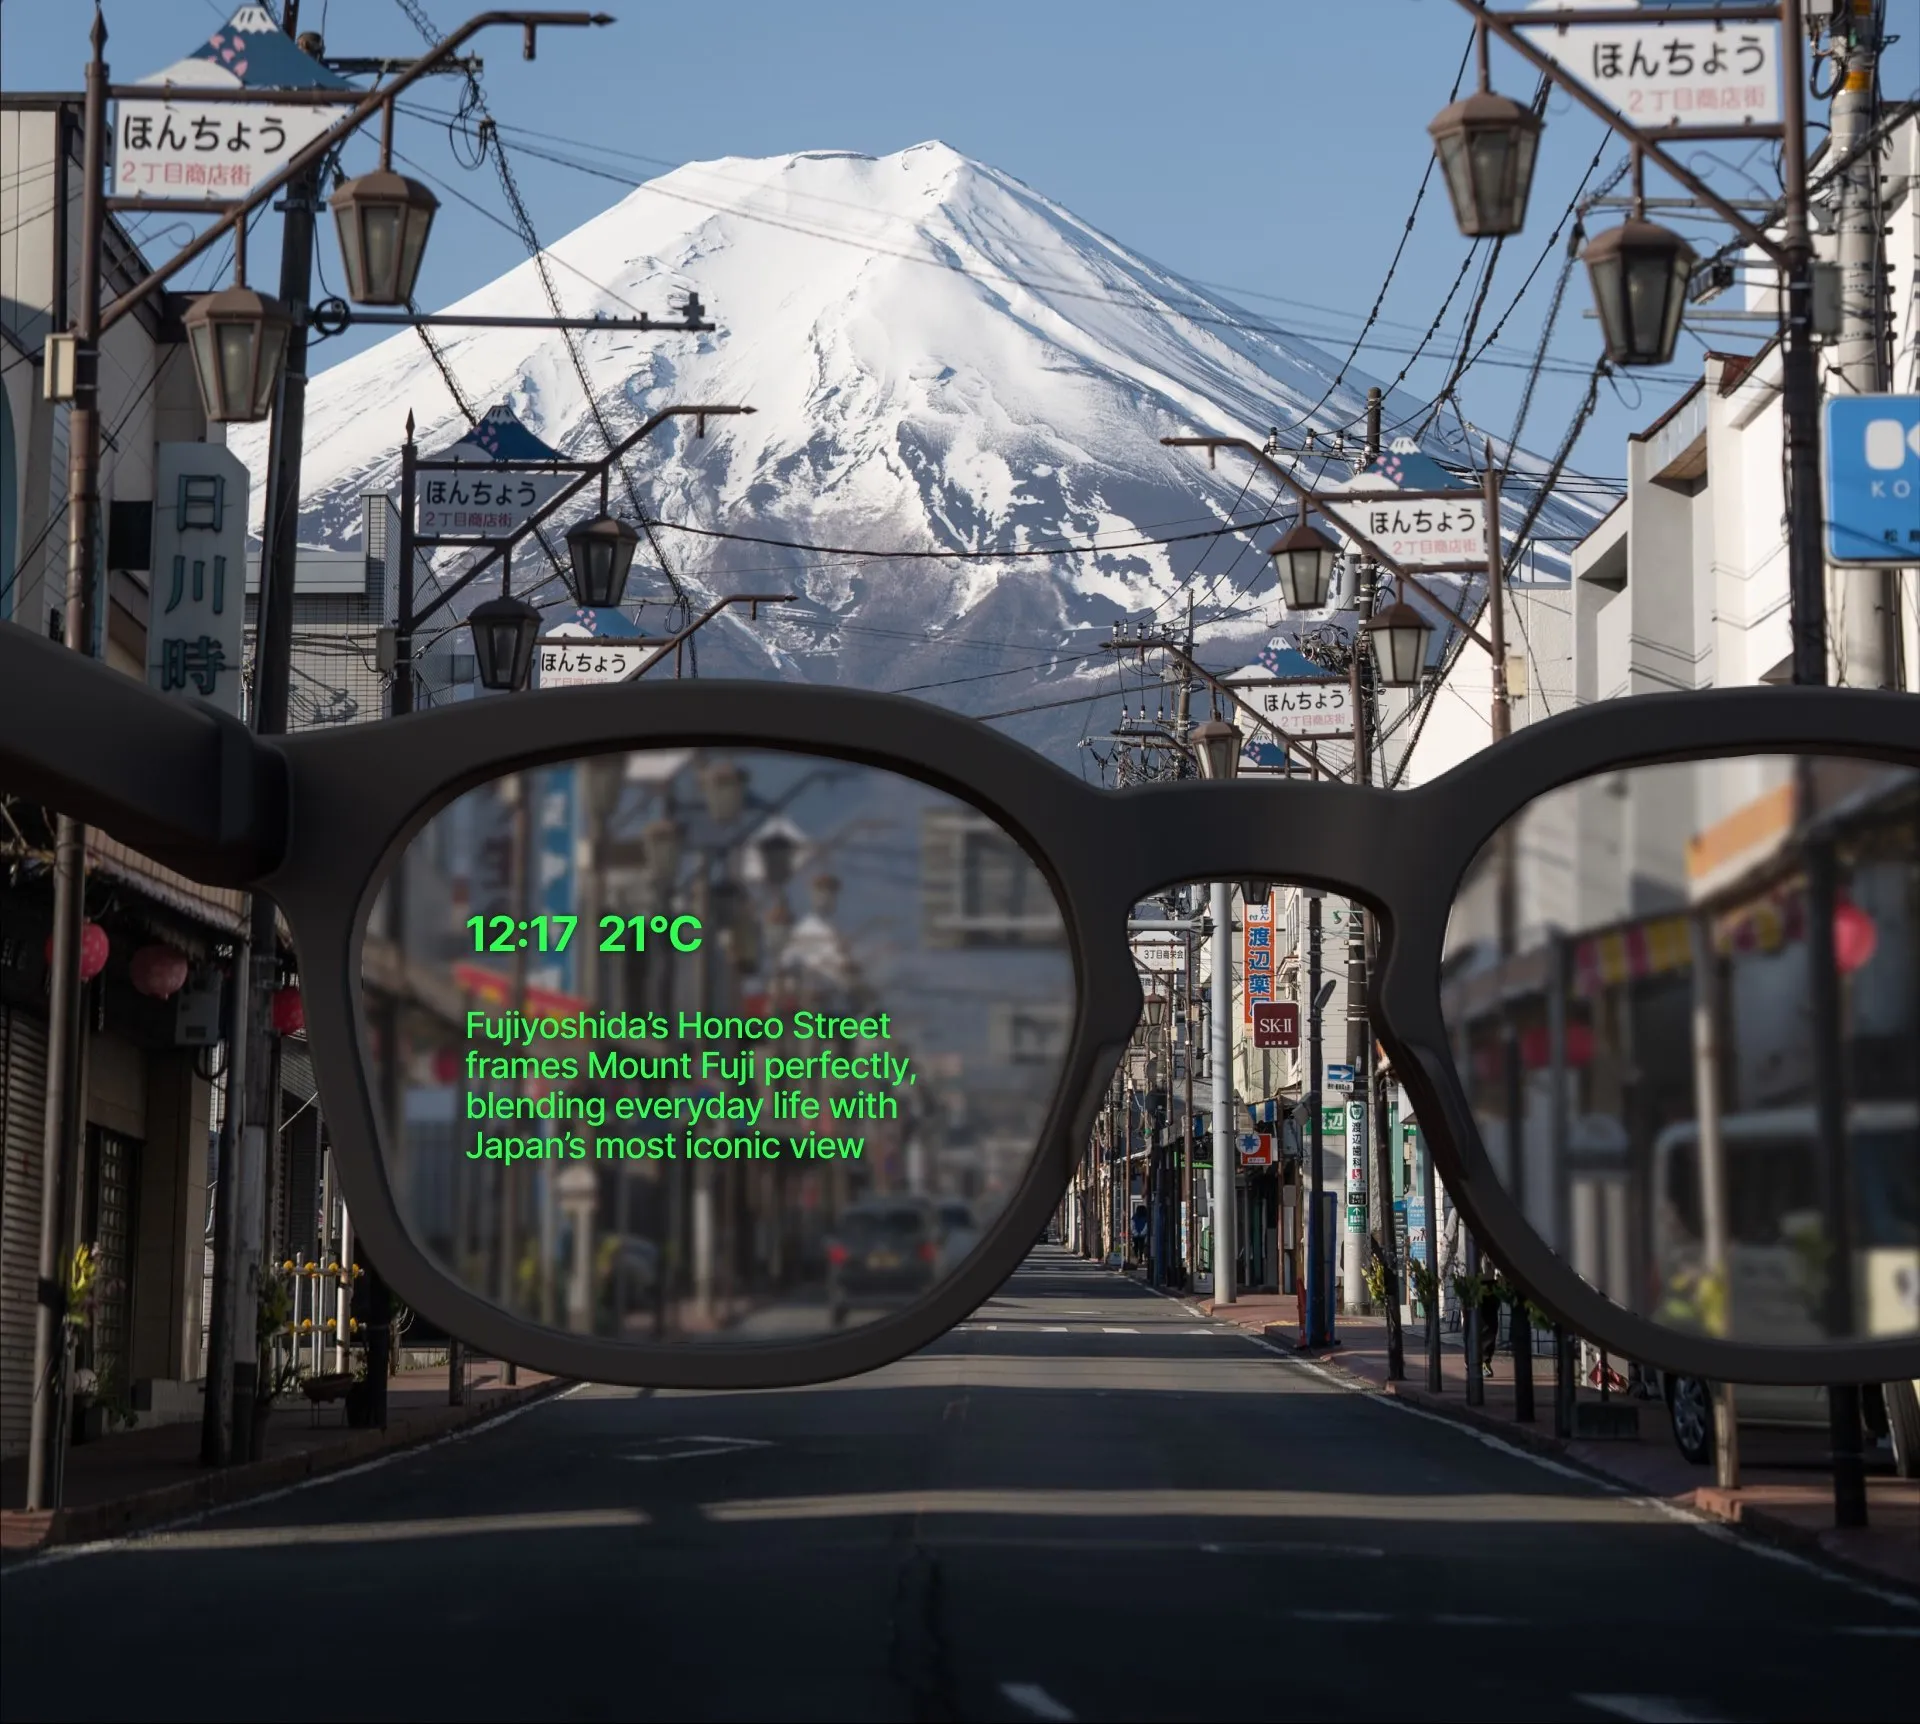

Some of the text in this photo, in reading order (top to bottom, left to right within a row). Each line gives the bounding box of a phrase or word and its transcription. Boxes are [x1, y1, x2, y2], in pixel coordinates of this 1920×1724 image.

[1592, 36, 1765, 79] ほんちょう
[1628, 84, 1766, 113] 2丁目商店街
[123, 114, 286, 154] ほんちょう
[122, 161, 252, 187] 2丁目商店街
[426, 480, 536, 507] ほんちょう
[425, 511, 512, 527] 2丁目商店街
[1370, 508, 1475, 534] ほんちょう
[1393, 538, 1477, 555] 2丁目商店街
[161, 474, 226, 696] 日川時
[541, 652, 626, 674] ほんちょう
[1264, 689, 1345, 712] ほんちょう
[1259, 1018, 1293, 1034] SK-II
